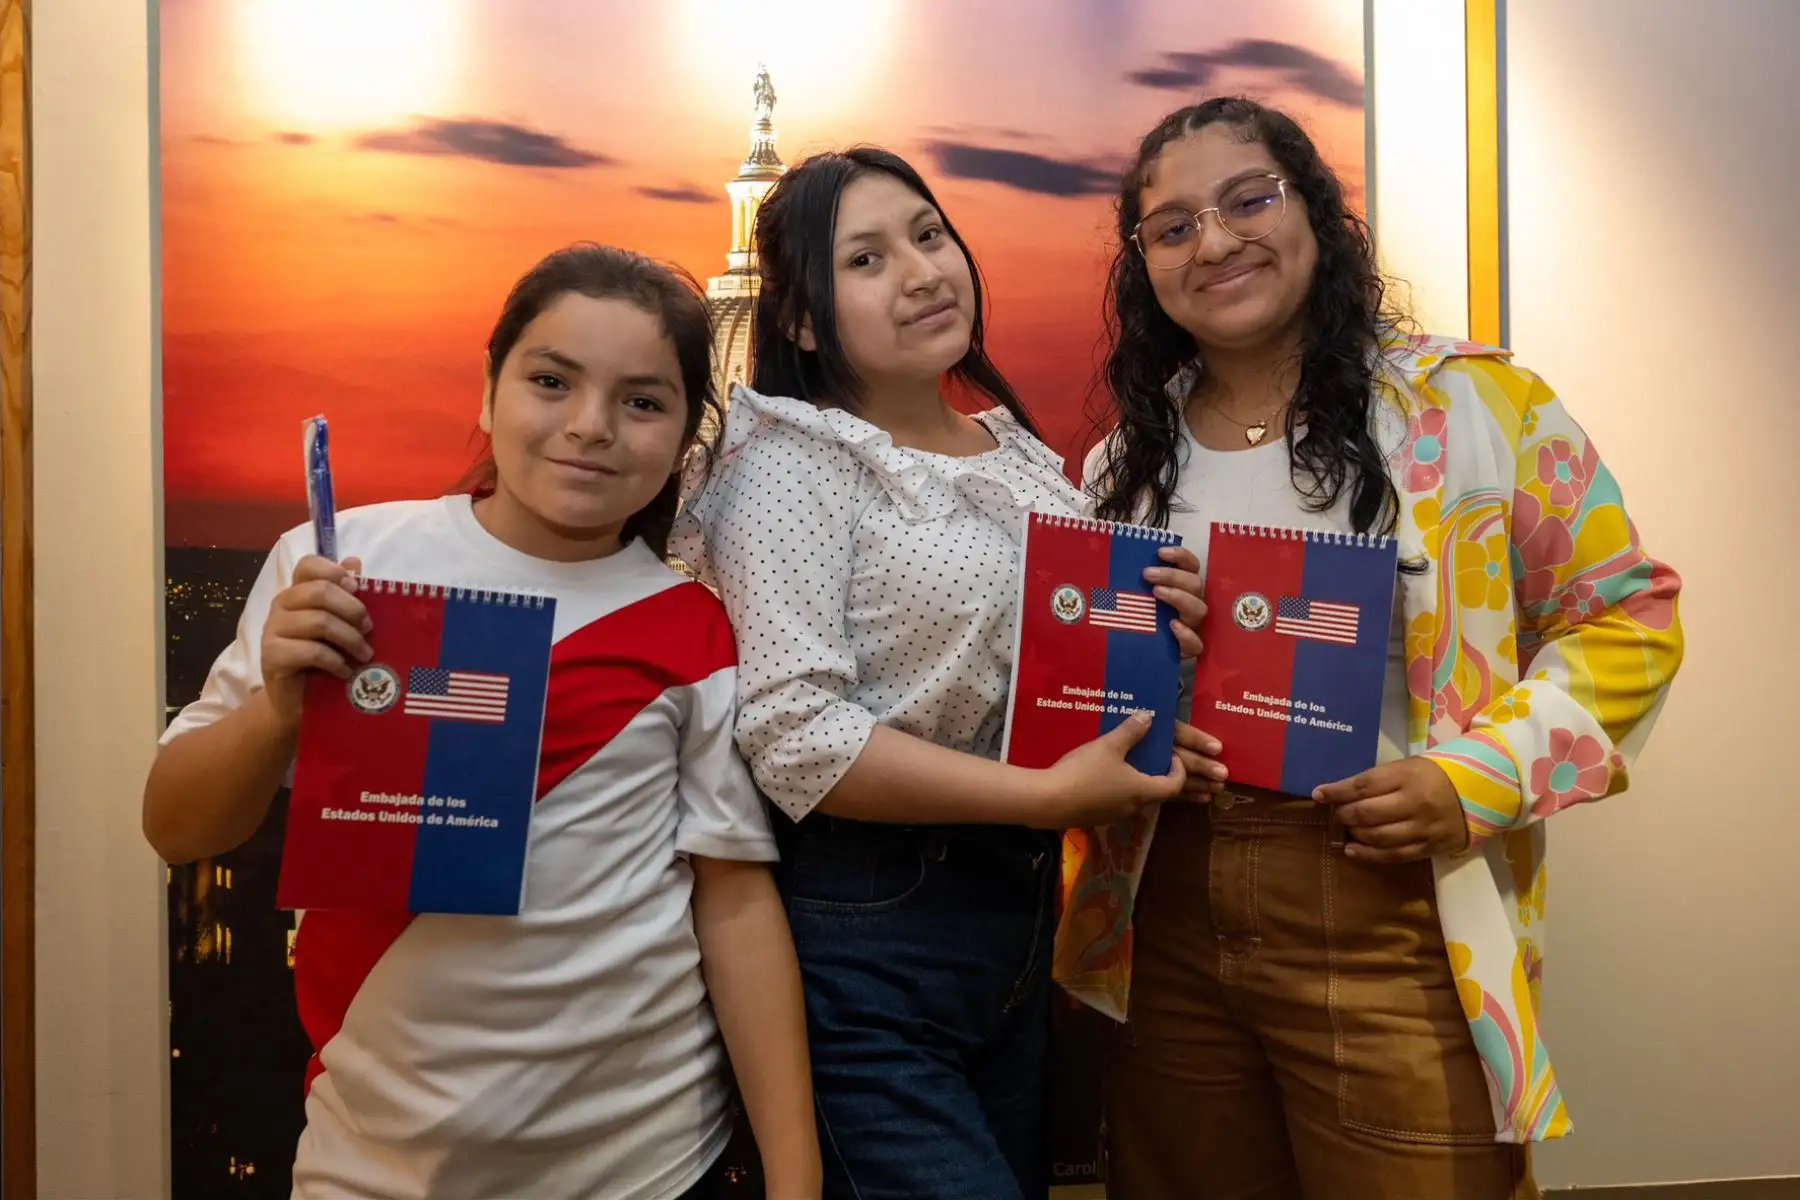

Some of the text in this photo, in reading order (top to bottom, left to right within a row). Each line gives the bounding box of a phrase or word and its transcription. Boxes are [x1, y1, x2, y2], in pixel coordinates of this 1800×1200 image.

[1062, 685, 1134, 701] Embajada de los
[1243, 691, 1326, 713] Embajada de los
[1036, 697, 1073, 710] Estados
[1074, 701, 1105, 713] Unidos
[1107, 704, 1119, 714] de
[1215, 700, 1353, 733] Estados Unidos de América
[360, 791, 467, 808] Embajada de los
[321, 807, 498, 828] Estados Unidos de América
[1053, 1159, 1096, 1178] Carol
